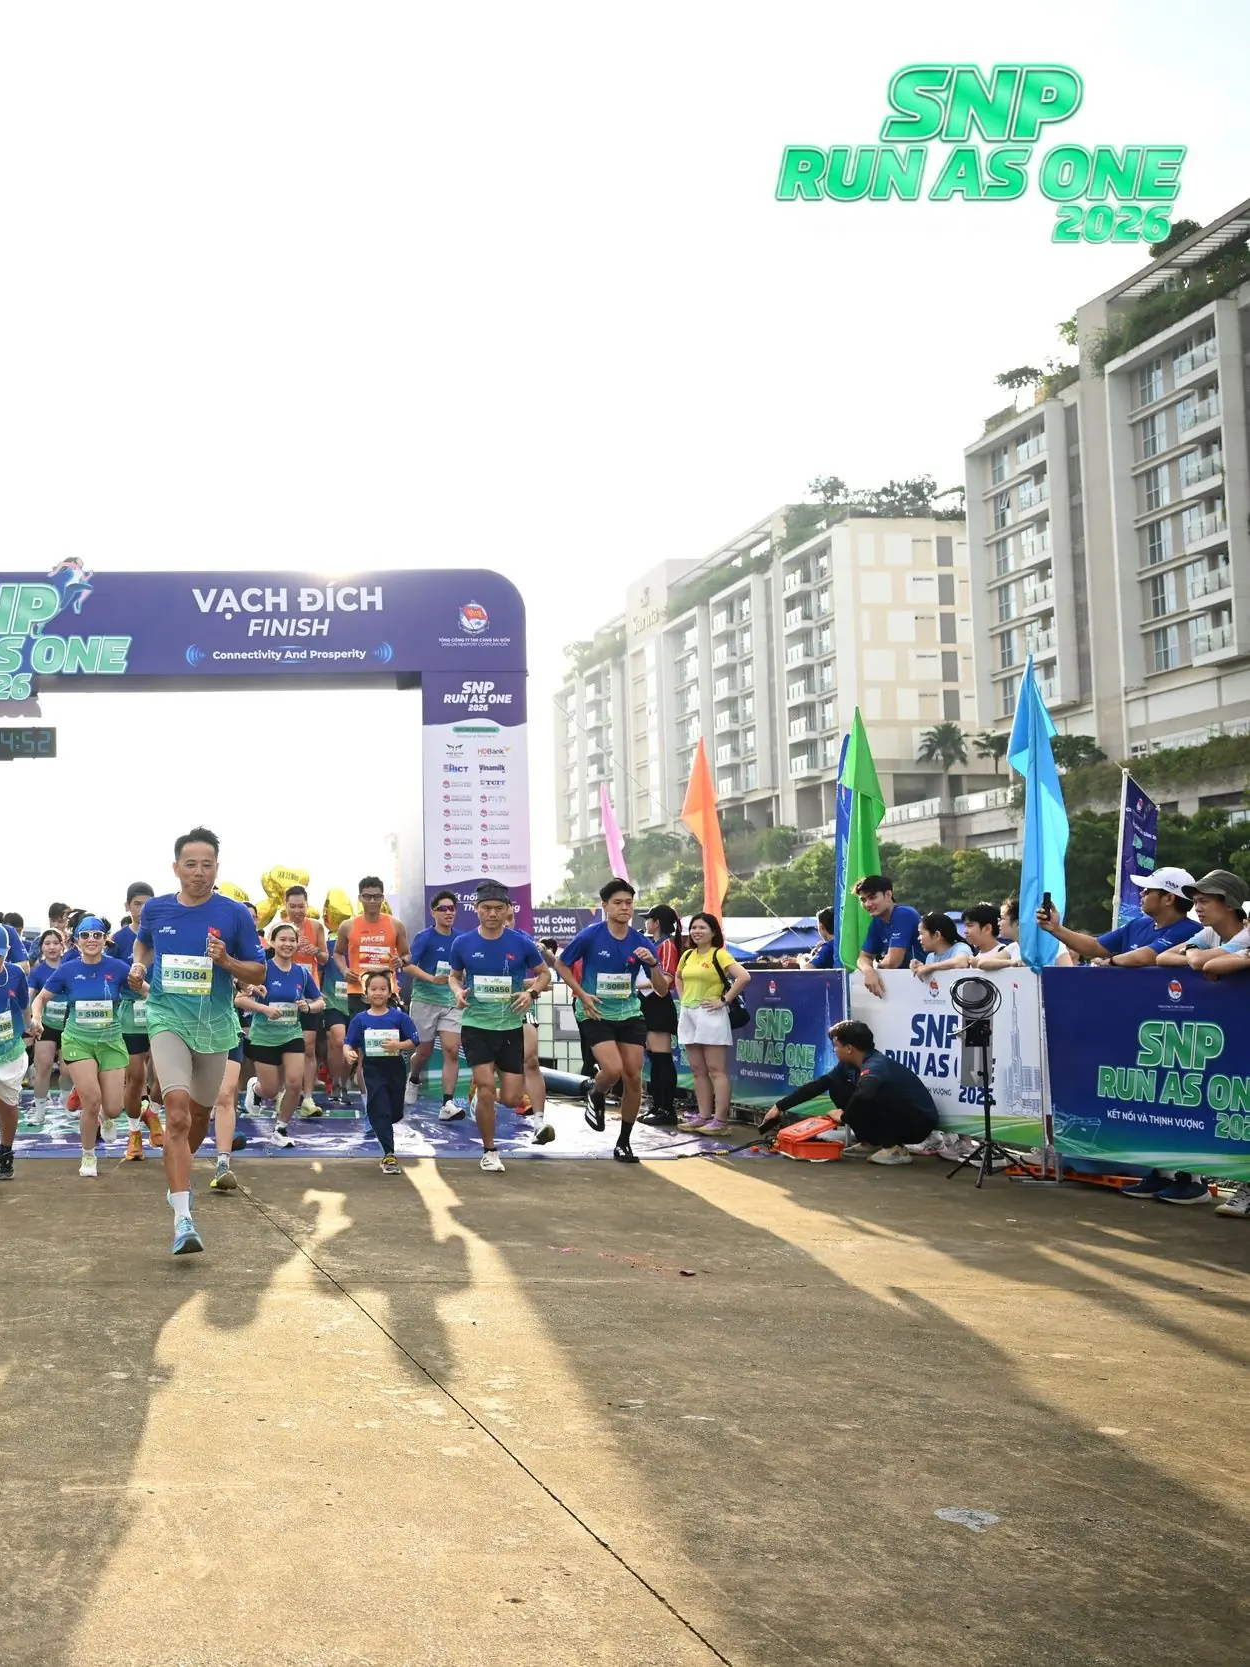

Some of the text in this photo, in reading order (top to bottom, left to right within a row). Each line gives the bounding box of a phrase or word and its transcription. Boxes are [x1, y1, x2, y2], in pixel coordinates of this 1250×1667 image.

[192, 582, 383, 620] VẠCH ĐÍCH
[248, 619, 330, 636] FINISH
[31, 636, 132, 674] ONE
[213, 650, 367, 661] Connectivity And Prosperity
[462, 681, 495, 694] SNP
[444, 694, 512, 704] RUN AS ONE
[468, 704, 489, 712] 2026
[553, 916, 576, 924] CÔNG
[174, 971, 207, 981] 51084
[755, 1008, 794, 1041] SNP
[736, 1039, 816, 1070] RUN AS ONE
[1137, 1021, 1224, 1070] SNP
[924, 1052, 950, 1078] AS
[1098, 1066, 1157, 1103] RUN
[1160, 1072, 1203, 1107] AS
[1108, 1108, 1205, 1130] KẾT NỐI VÀ THỊNH VƯỢNG
